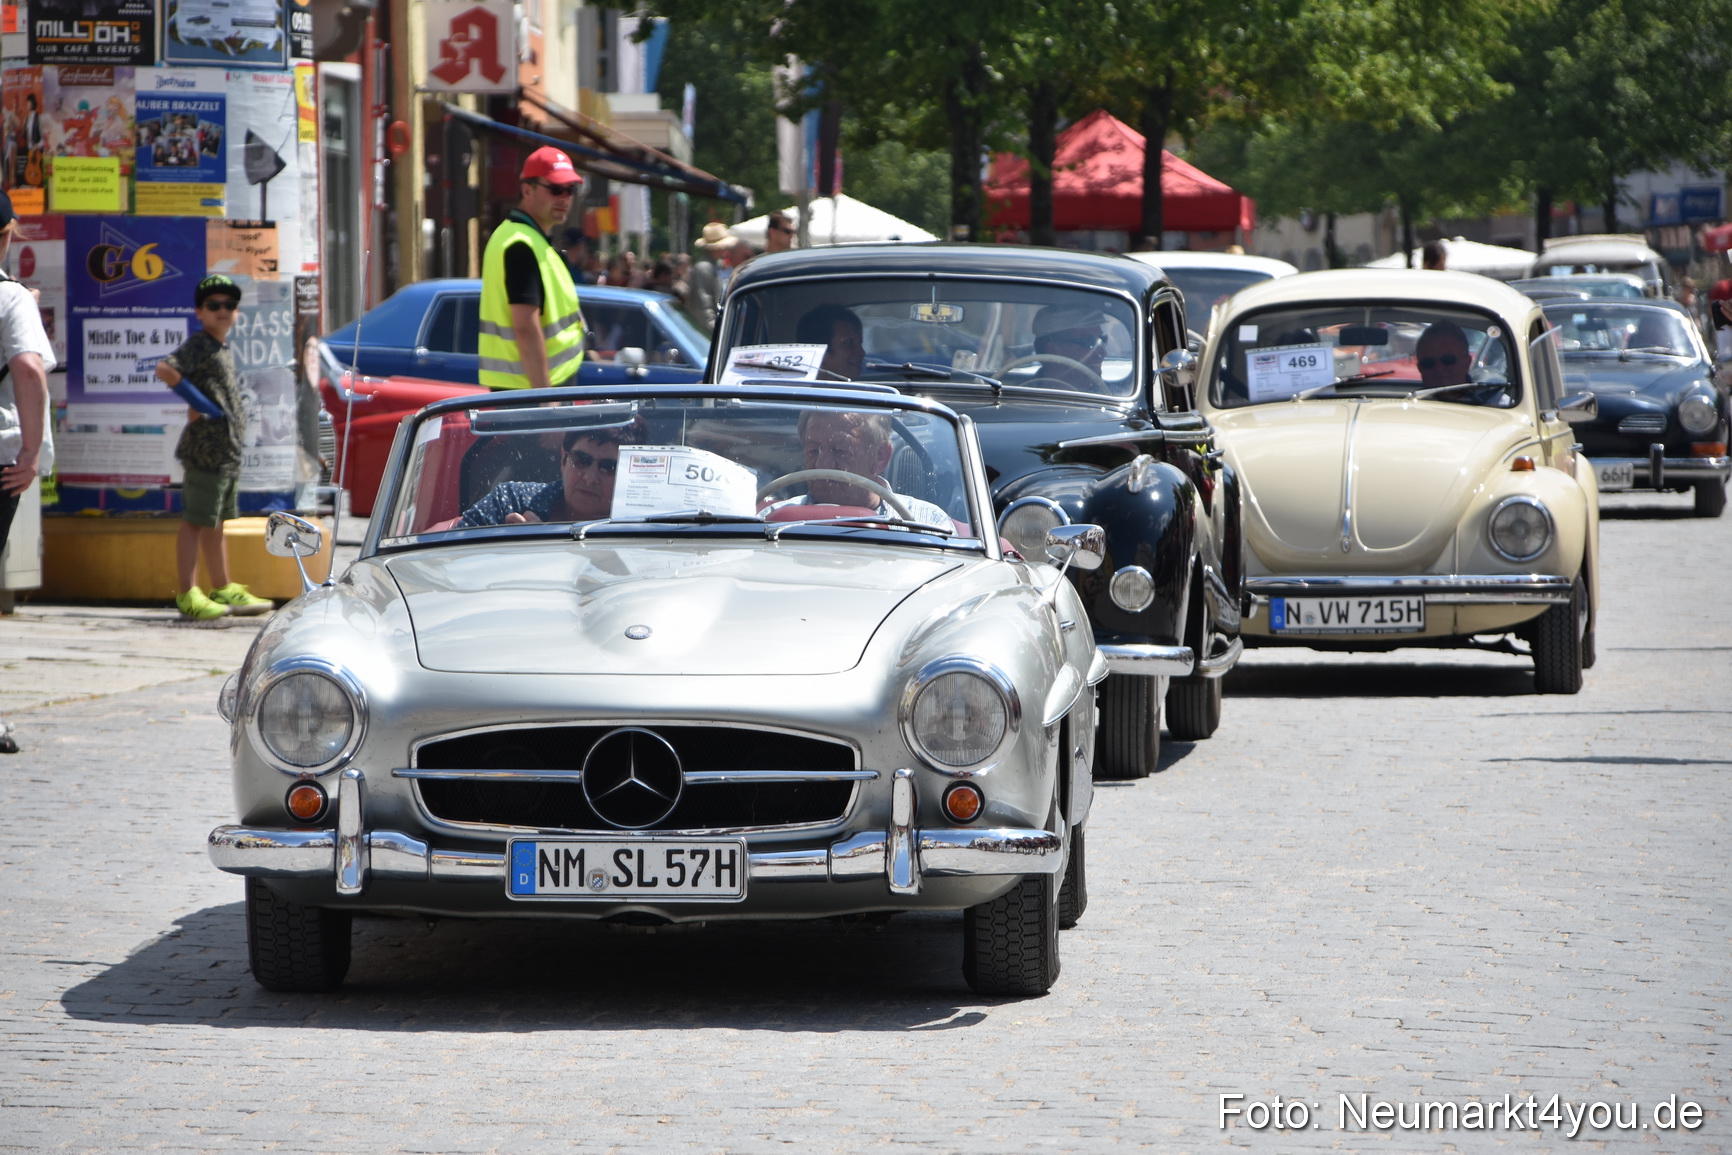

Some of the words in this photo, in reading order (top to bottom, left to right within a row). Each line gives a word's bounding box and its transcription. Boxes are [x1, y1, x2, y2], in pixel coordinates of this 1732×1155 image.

[97, 45, 141, 54] EVENTS
[87, 329, 121, 346] Mistle
[124, 329, 146, 345] Toe
[164, 329, 184, 346] Ivy
[230, 339, 284, 366] NDA
[1288, 355, 1317, 368] 469
[1601, 467, 1631, 482] 66H
[1286, 601, 1301, 625] N
[1319, 601, 1350, 625] VW
[1358, 600, 1422, 624] 715H
[538, 848, 585, 888] NM
[519, 873, 529, 885] D
